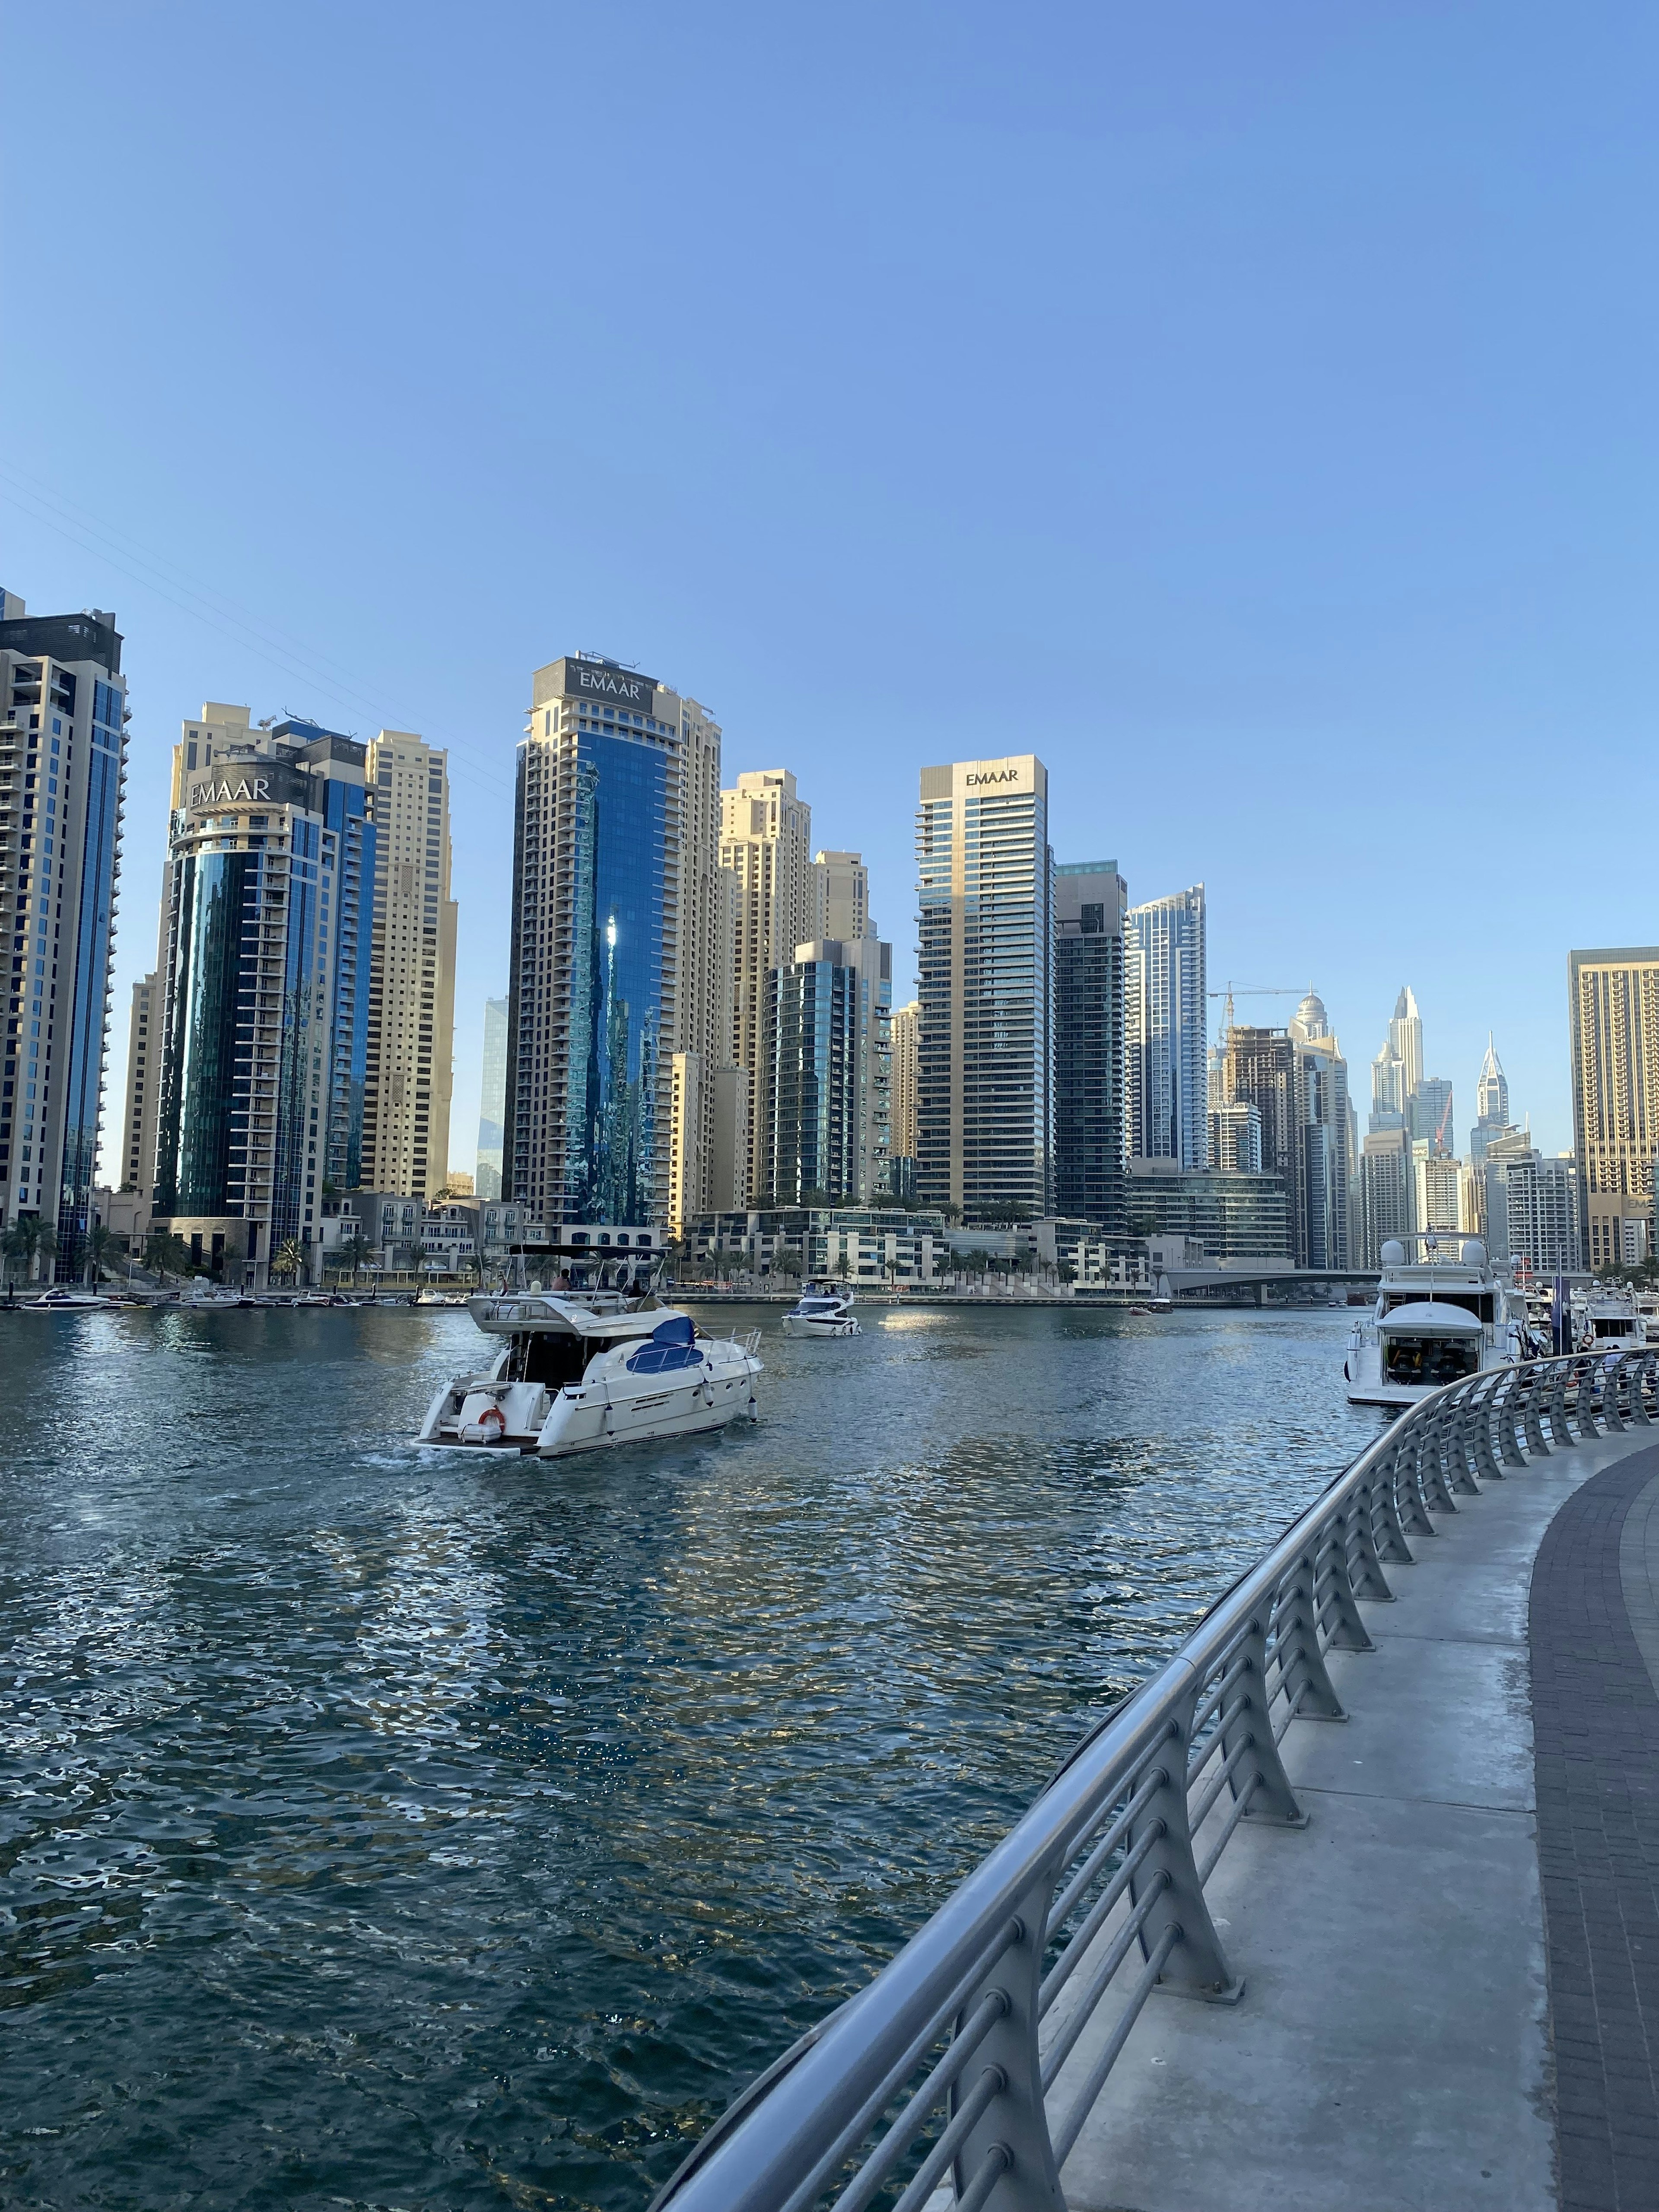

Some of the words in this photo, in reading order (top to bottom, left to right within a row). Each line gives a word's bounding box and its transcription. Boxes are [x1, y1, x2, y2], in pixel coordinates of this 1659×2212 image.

[580, 672, 640, 700] EMAAR
[966, 769, 1019, 786] EMAAR
[191, 779, 271, 807] EMAAR
